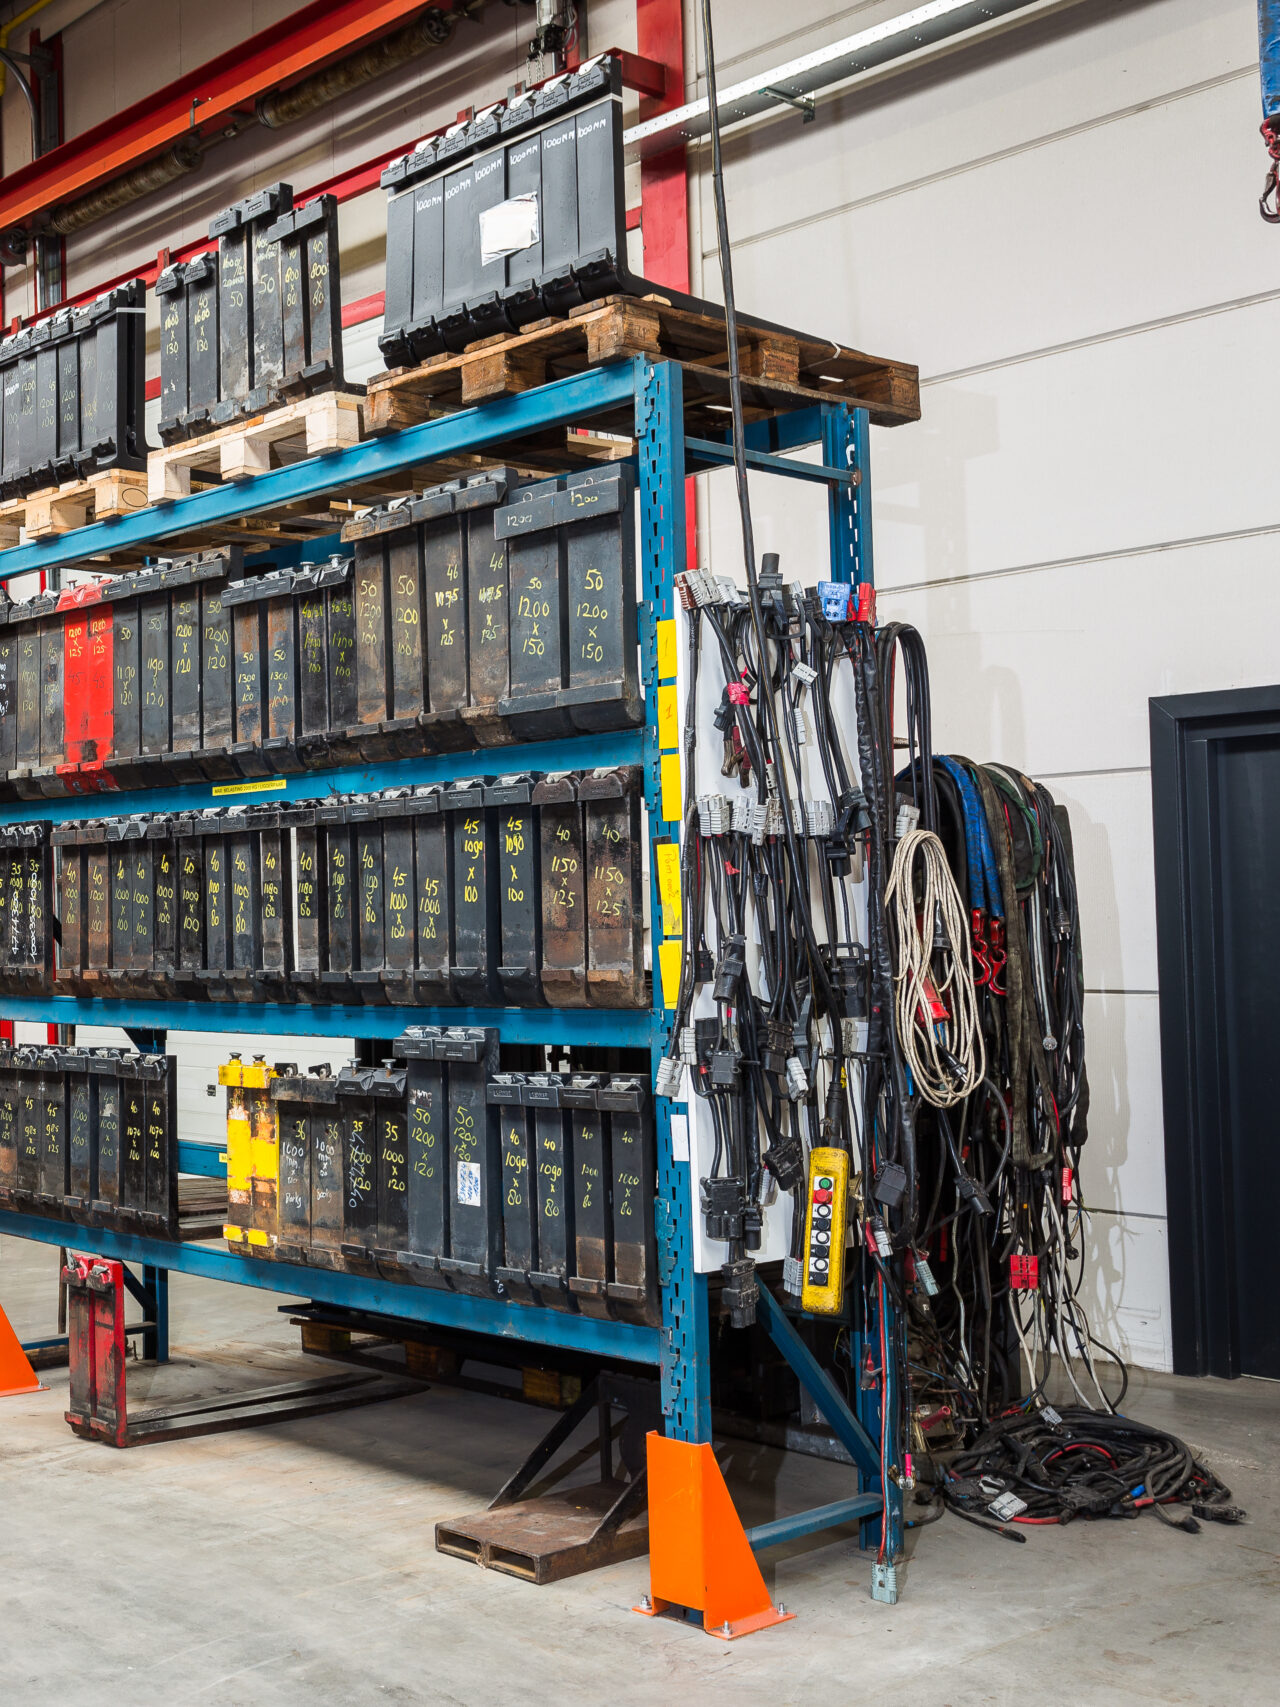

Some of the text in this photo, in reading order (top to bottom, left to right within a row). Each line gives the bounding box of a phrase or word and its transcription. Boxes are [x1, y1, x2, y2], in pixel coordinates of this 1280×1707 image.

[313, 241, 323, 253] 40
[258, 274, 275, 294] 50
[230, 295, 243, 307] 50
[167, 342, 178, 354] 130
[197, 340, 208, 352] 130
[571, 494, 597, 506] 1200
[507, 514, 532, 526] 1200
[361, 580, 376, 596] 50
[398, 575, 414, 595] 50
[529, 578, 542, 589] 50
[585, 570, 603, 590] 50
[179, 603, 190, 615] 50
[518, 596, 549, 617] 1200
[577, 603, 607, 619] 1200
[121, 628, 131, 640] 50
[94, 646, 105, 654] 125
[523, 639, 545, 655] 150
[582, 644, 603, 662] 150
[241, 653, 253, 663] 50
[274, 650, 286, 661] 50
[176, 660, 191, 673] 120
[208, 659, 226, 669] 120
[120, 691, 132, 705] 120
[146, 693, 163, 707] 120
[464, 820, 479, 834] 45
[508, 817, 523, 831] 45
[557, 826, 570, 841] 40
[602, 825, 620, 843] 40
[161, 854, 168, 873] 40
[211, 850, 219, 872] 40
[235, 853, 245, 872] 40
[266, 852, 275, 869] 40
[301, 852, 312, 871] 40
[363, 844, 373, 868] 40
[67, 862, 75, 883] 40
[137, 863, 144, 879] 40
[184, 857, 194, 874] 40
[552, 857, 577, 874] 1150
[93, 866, 102, 885] 40
[393, 867, 408, 887] 45
[595, 867, 623, 884] 1150
[157, 884, 173, 898] 1000
[426, 878, 439, 896] 45
[508, 888, 523, 901] 100
[420, 899, 440, 914] 1000
[553, 890, 575, 907] 125
[597, 901, 622, 916] 125
[184, 917, 199, 932] 100
[236, 914, 245, 933] 80
[413, 1108, 431, 1124] 50
[455, 1106, 473, 1128] 50
[353, 1121, 363, 1132] 35
[385, 1122, 398, 1141] 35
[412, 1128, 435, 1147] 1200
[454, 1127, 477, 1146] 1200
[510, 1129, 519, 1145] 40
[544, 1138, 555, 1151] 40
[383, 1148, 404, 1164] 1000
[414, 1162, 434, 1177] 120
[388, 1179, 405, 1191] 120
[545, 1199, 559, 1216] 80
